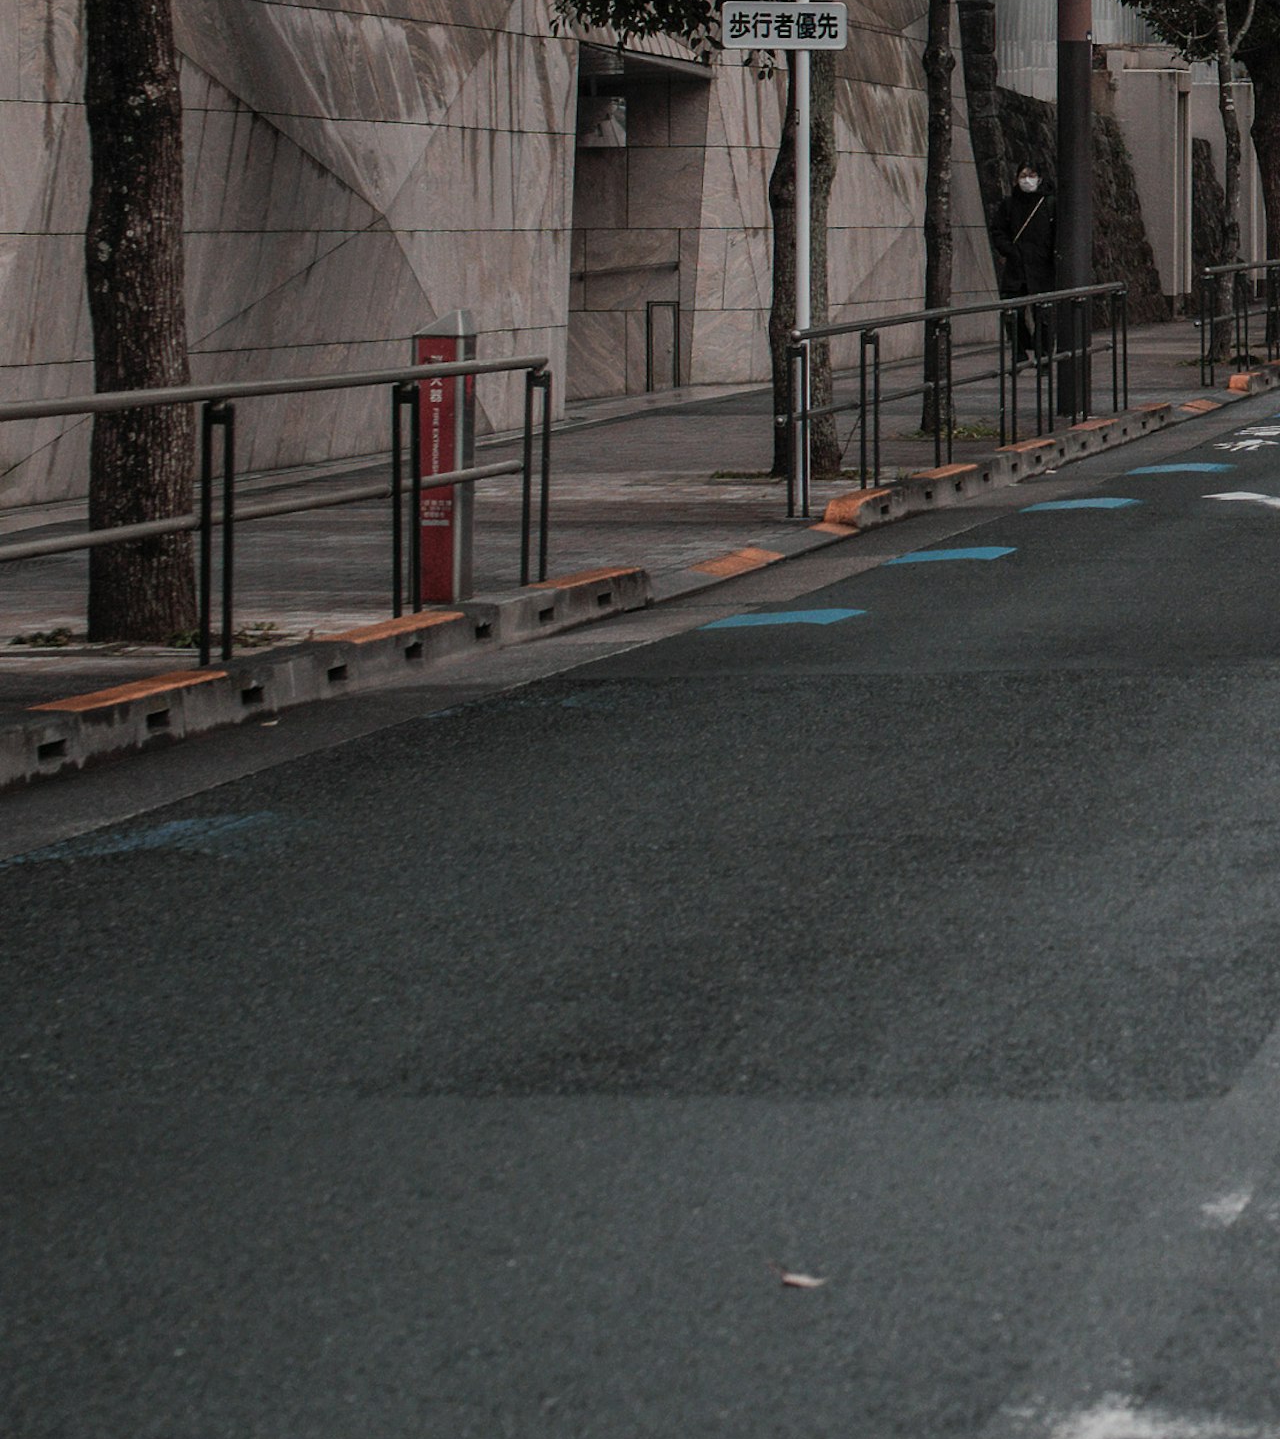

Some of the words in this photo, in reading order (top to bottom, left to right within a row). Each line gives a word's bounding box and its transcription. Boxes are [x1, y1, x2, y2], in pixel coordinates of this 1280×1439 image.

[729, 11, 839, 40] 歩行者優先
